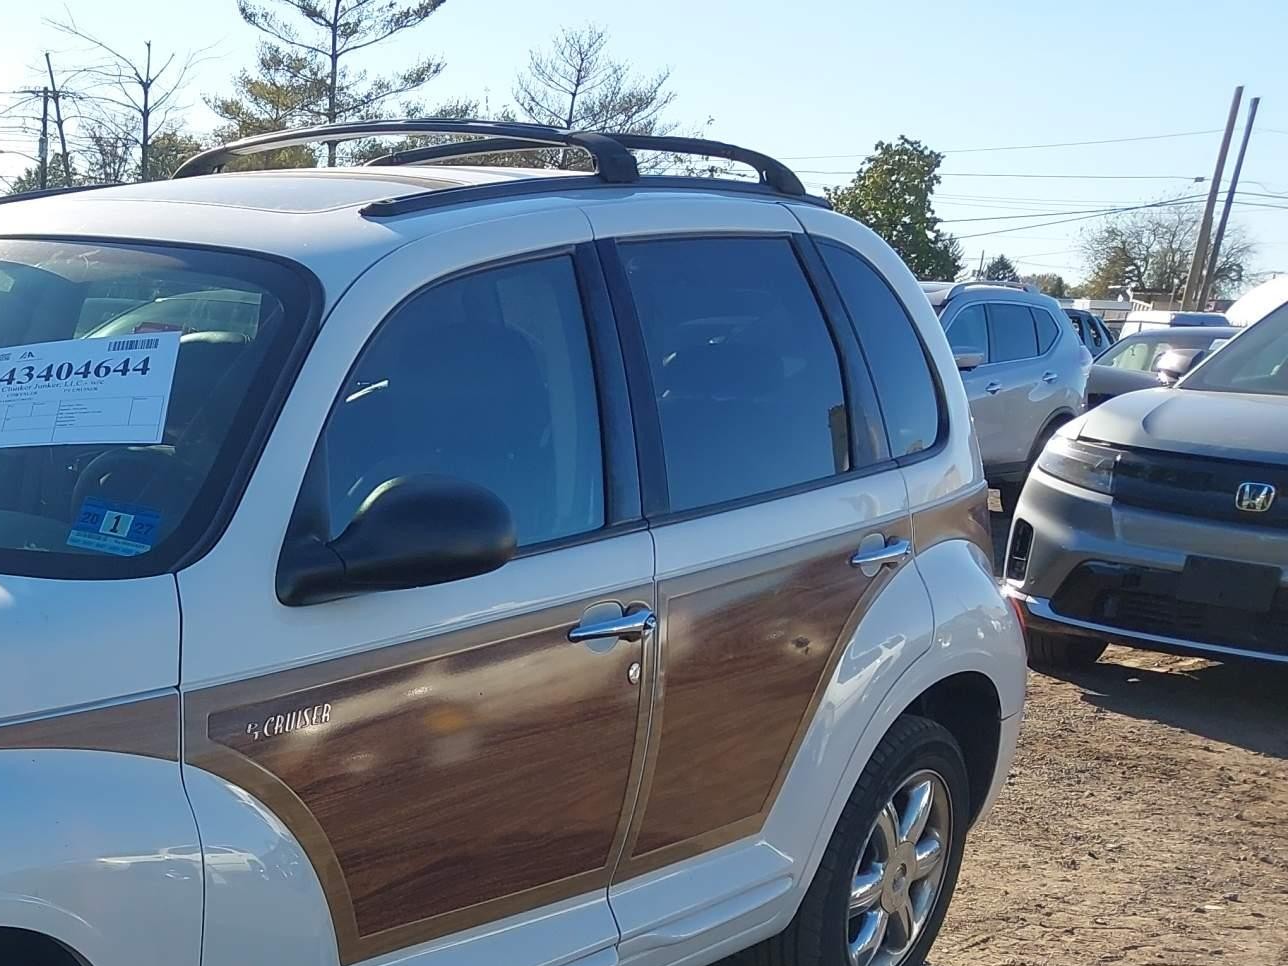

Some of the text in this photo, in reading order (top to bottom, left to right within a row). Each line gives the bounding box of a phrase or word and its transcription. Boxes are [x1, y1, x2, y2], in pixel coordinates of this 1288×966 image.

[110, 514, 122, 533] 1
[247, 703, 332, 740] PT CRUISER
